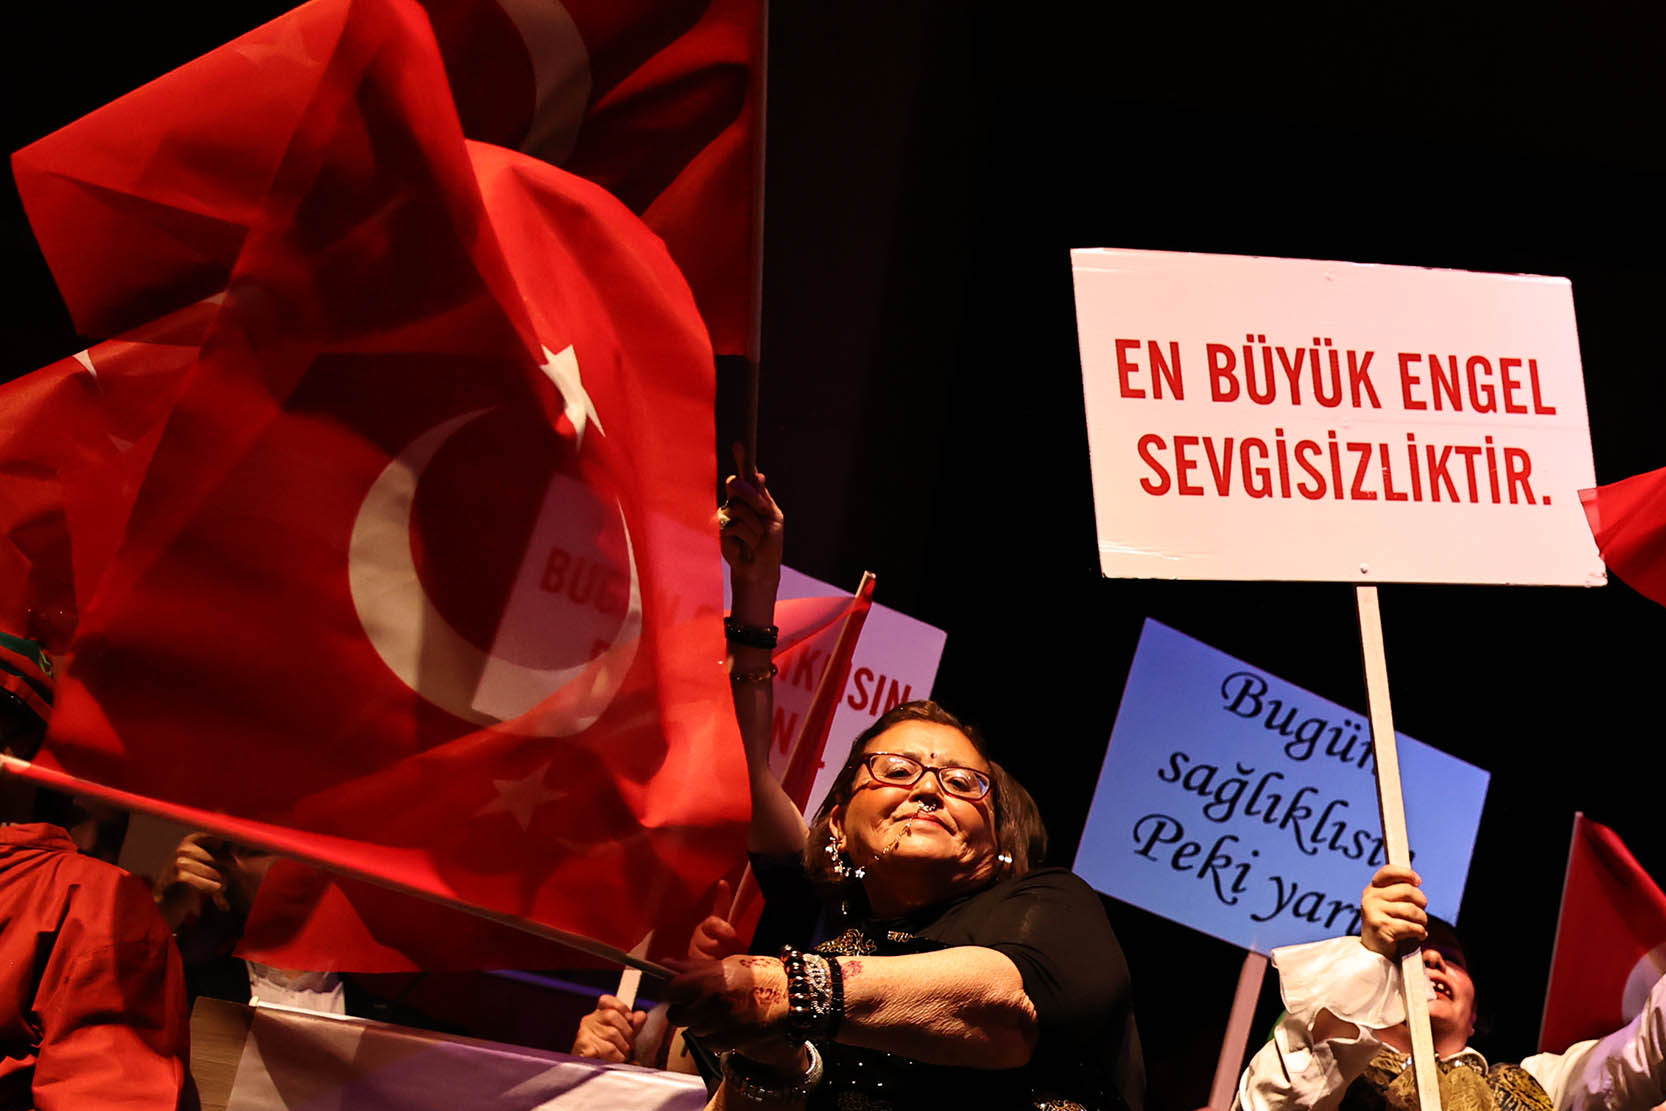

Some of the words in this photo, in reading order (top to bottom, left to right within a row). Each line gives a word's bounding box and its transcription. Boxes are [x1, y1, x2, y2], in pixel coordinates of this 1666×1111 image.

[1115, 338, 1185, 401] EN
[1206, 333, 1382, 409] BÜYÜK
[1398, 351, 1557, 416] ENGEL
[1136, 427, 1552, 506] SEVGİSİZLİKTİR.
[1158, 751, 1415, 868] sağlıklısı
[1133, 813, 1260, 906] Peki
